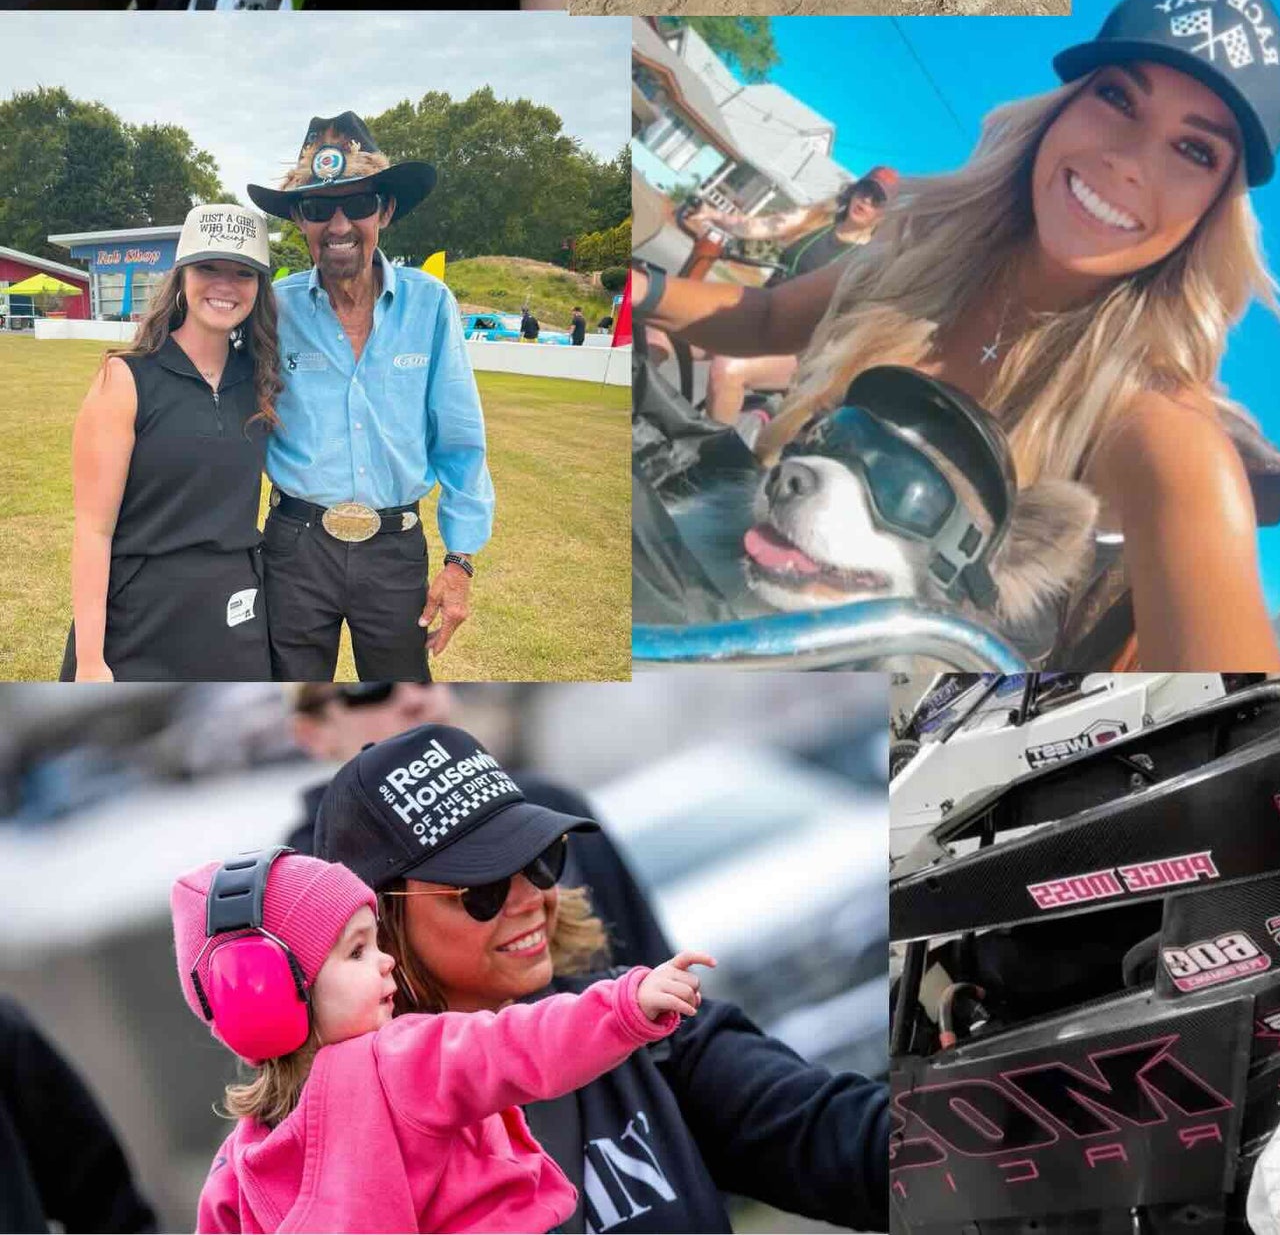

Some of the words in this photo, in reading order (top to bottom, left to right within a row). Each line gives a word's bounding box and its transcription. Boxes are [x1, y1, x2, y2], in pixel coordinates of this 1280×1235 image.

[199, 213, 224, 224] JUST
[226, 214, 235, 222] A
[236, 215, 256, 228] GIRL
[200, 223, 224, 234] WHO
[227, 224, 257, 238] LOVES
[386, 738, 453, 787] Real
[379, 783, 397, 805] the
[412, 814, 432, 835] OF
[433, 794, 465, 819] THE
[462, 773, 493, 797] DIRT
